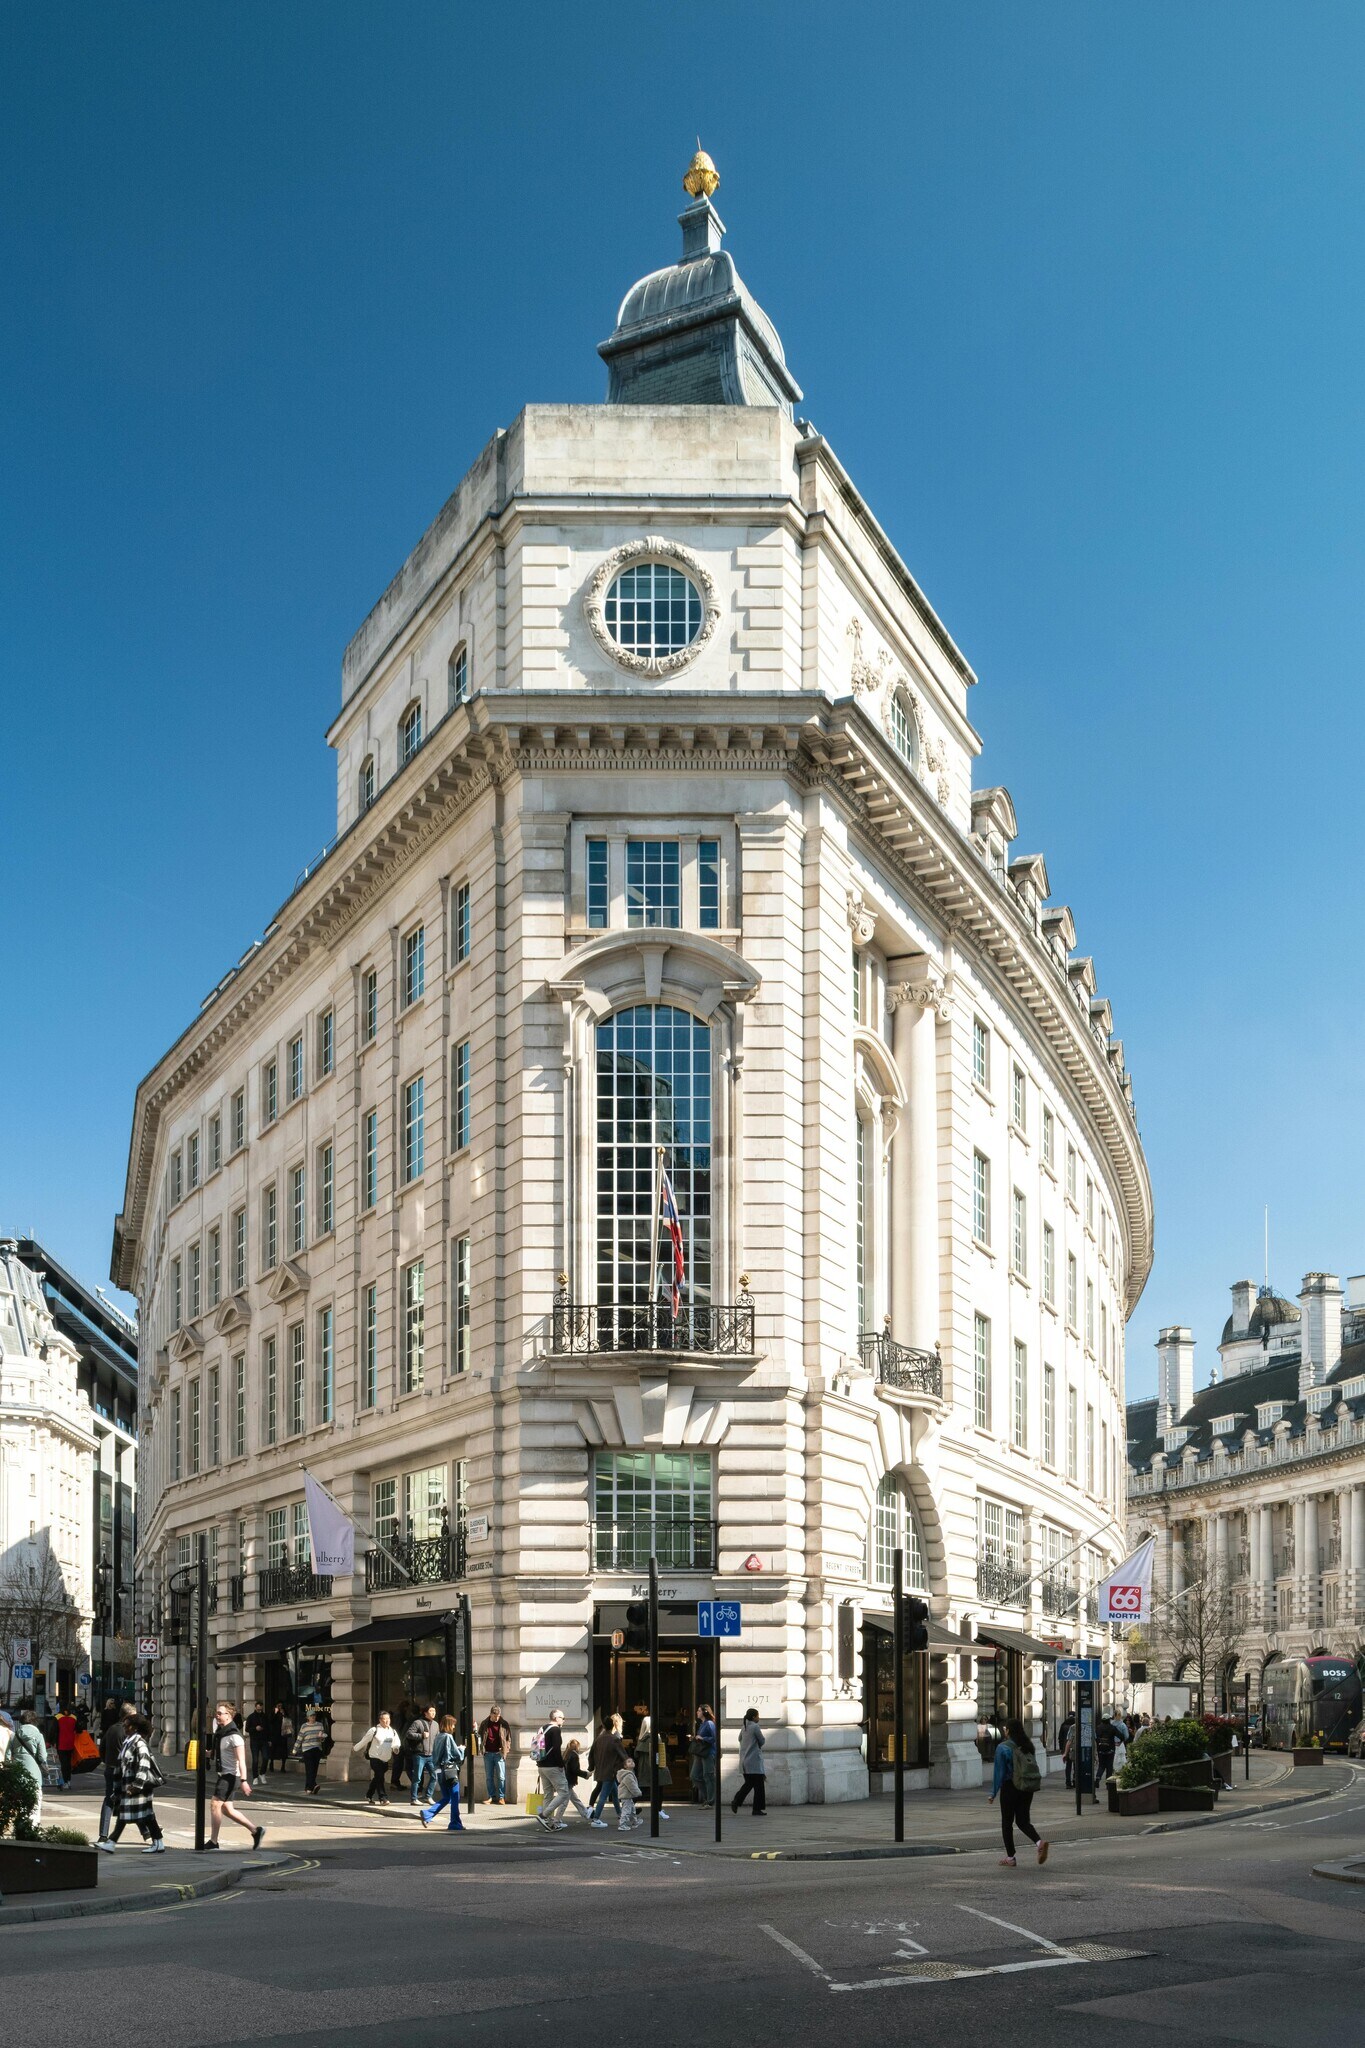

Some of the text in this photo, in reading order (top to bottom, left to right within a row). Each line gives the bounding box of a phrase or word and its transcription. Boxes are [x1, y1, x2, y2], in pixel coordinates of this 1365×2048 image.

[316, 1551, 345, 1565] ulberry
[632, 1584, 678, 1598] Muerry
[536, 1694, 572, 1708] Mulberry
[747, 1695, 770, 1705] 1971
